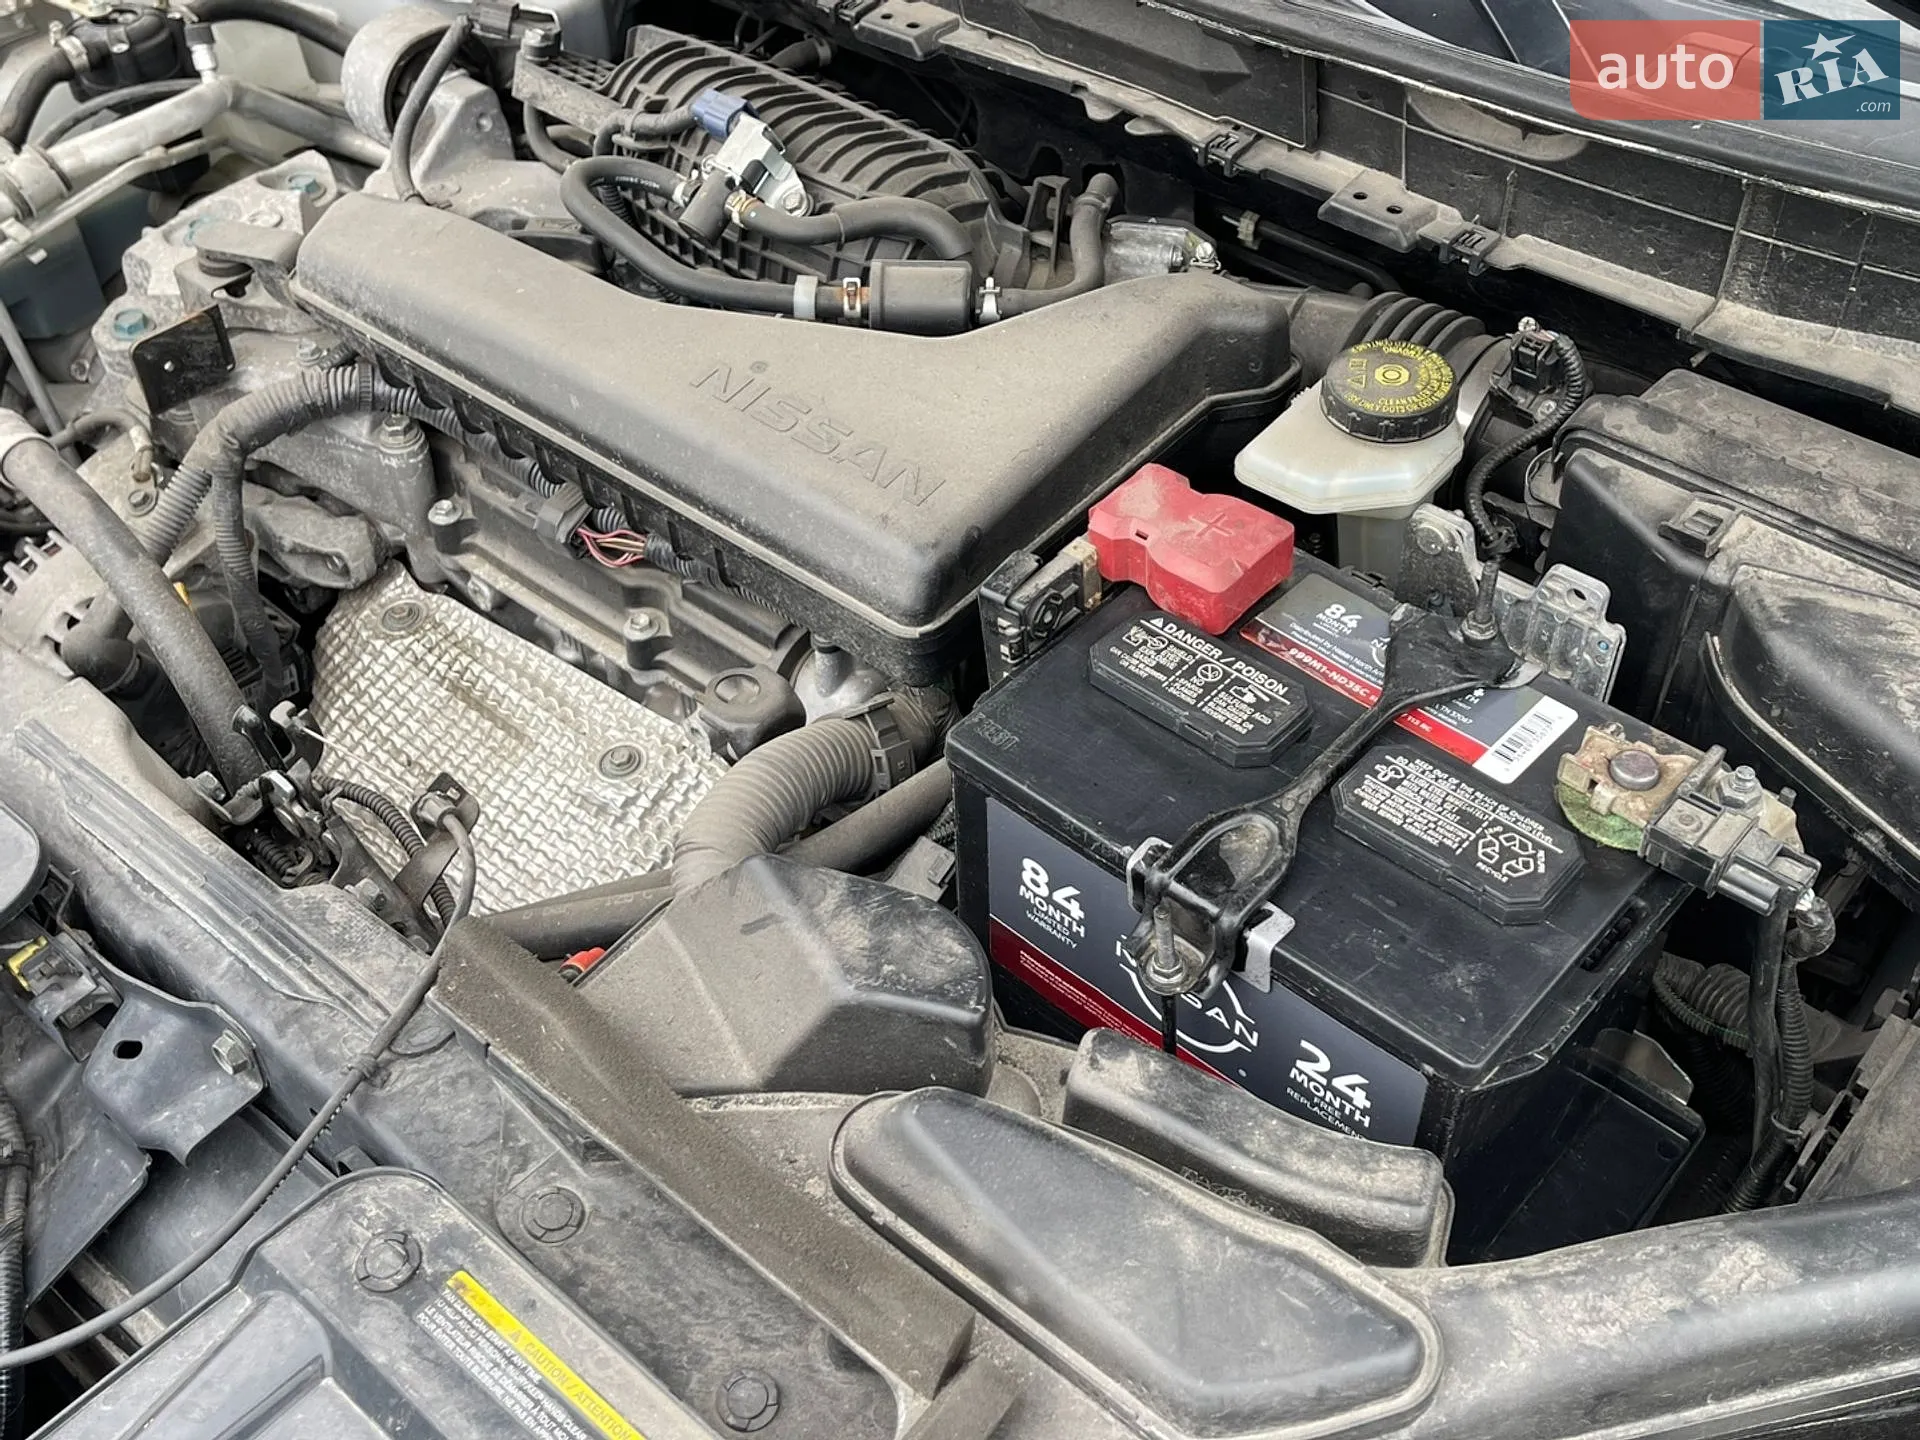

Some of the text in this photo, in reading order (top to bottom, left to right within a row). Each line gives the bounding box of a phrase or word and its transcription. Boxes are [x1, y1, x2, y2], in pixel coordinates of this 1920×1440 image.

[689, 363, 947, 508] NISSAN
[1316, 613, 1352, 635] MONTH
[1324, 603, 1363, 629] 84
[1163, 622, 1288, 695] DANGER / POISON
[1190, 676, 1205, 686] NO
[1217, 691, 1271, 724] SULFURIC ACID
[1414, 758, 1433, 770] KEEP
[1432, 768, 1448, 779] OUT
[1459, 783, 1474, 793] THE
[1473, 791, 1498, 806] REACH
[1497, 804, 1508, 812] OF
[1508, 809, 1544, 831] CHILDREN
[1423, 800, 1442, 812] HELP
[1532, 830, 1552, 843] LEVEL
[1021, 857, 1085, 921] 84
[1476, 861, 1509, 883] RECYCLE
[1019, 884, 1086, 938] MONTH
[1026, 909, 1077, 949] WARRANTY
[1033, 906, 1070, 936] LIMITED
[1295, 1039, 1372, 1110] 24
[1286, 1086, 1366, 1140] REPLACEMEN
[1289, 1067, 1371, 1128] MONTH
[1313, 1096, 1342, 1120] FREE
[524, 1342, 568, 1383] CAUTION
[573, 1390, 634, 1440] ATTENTION
